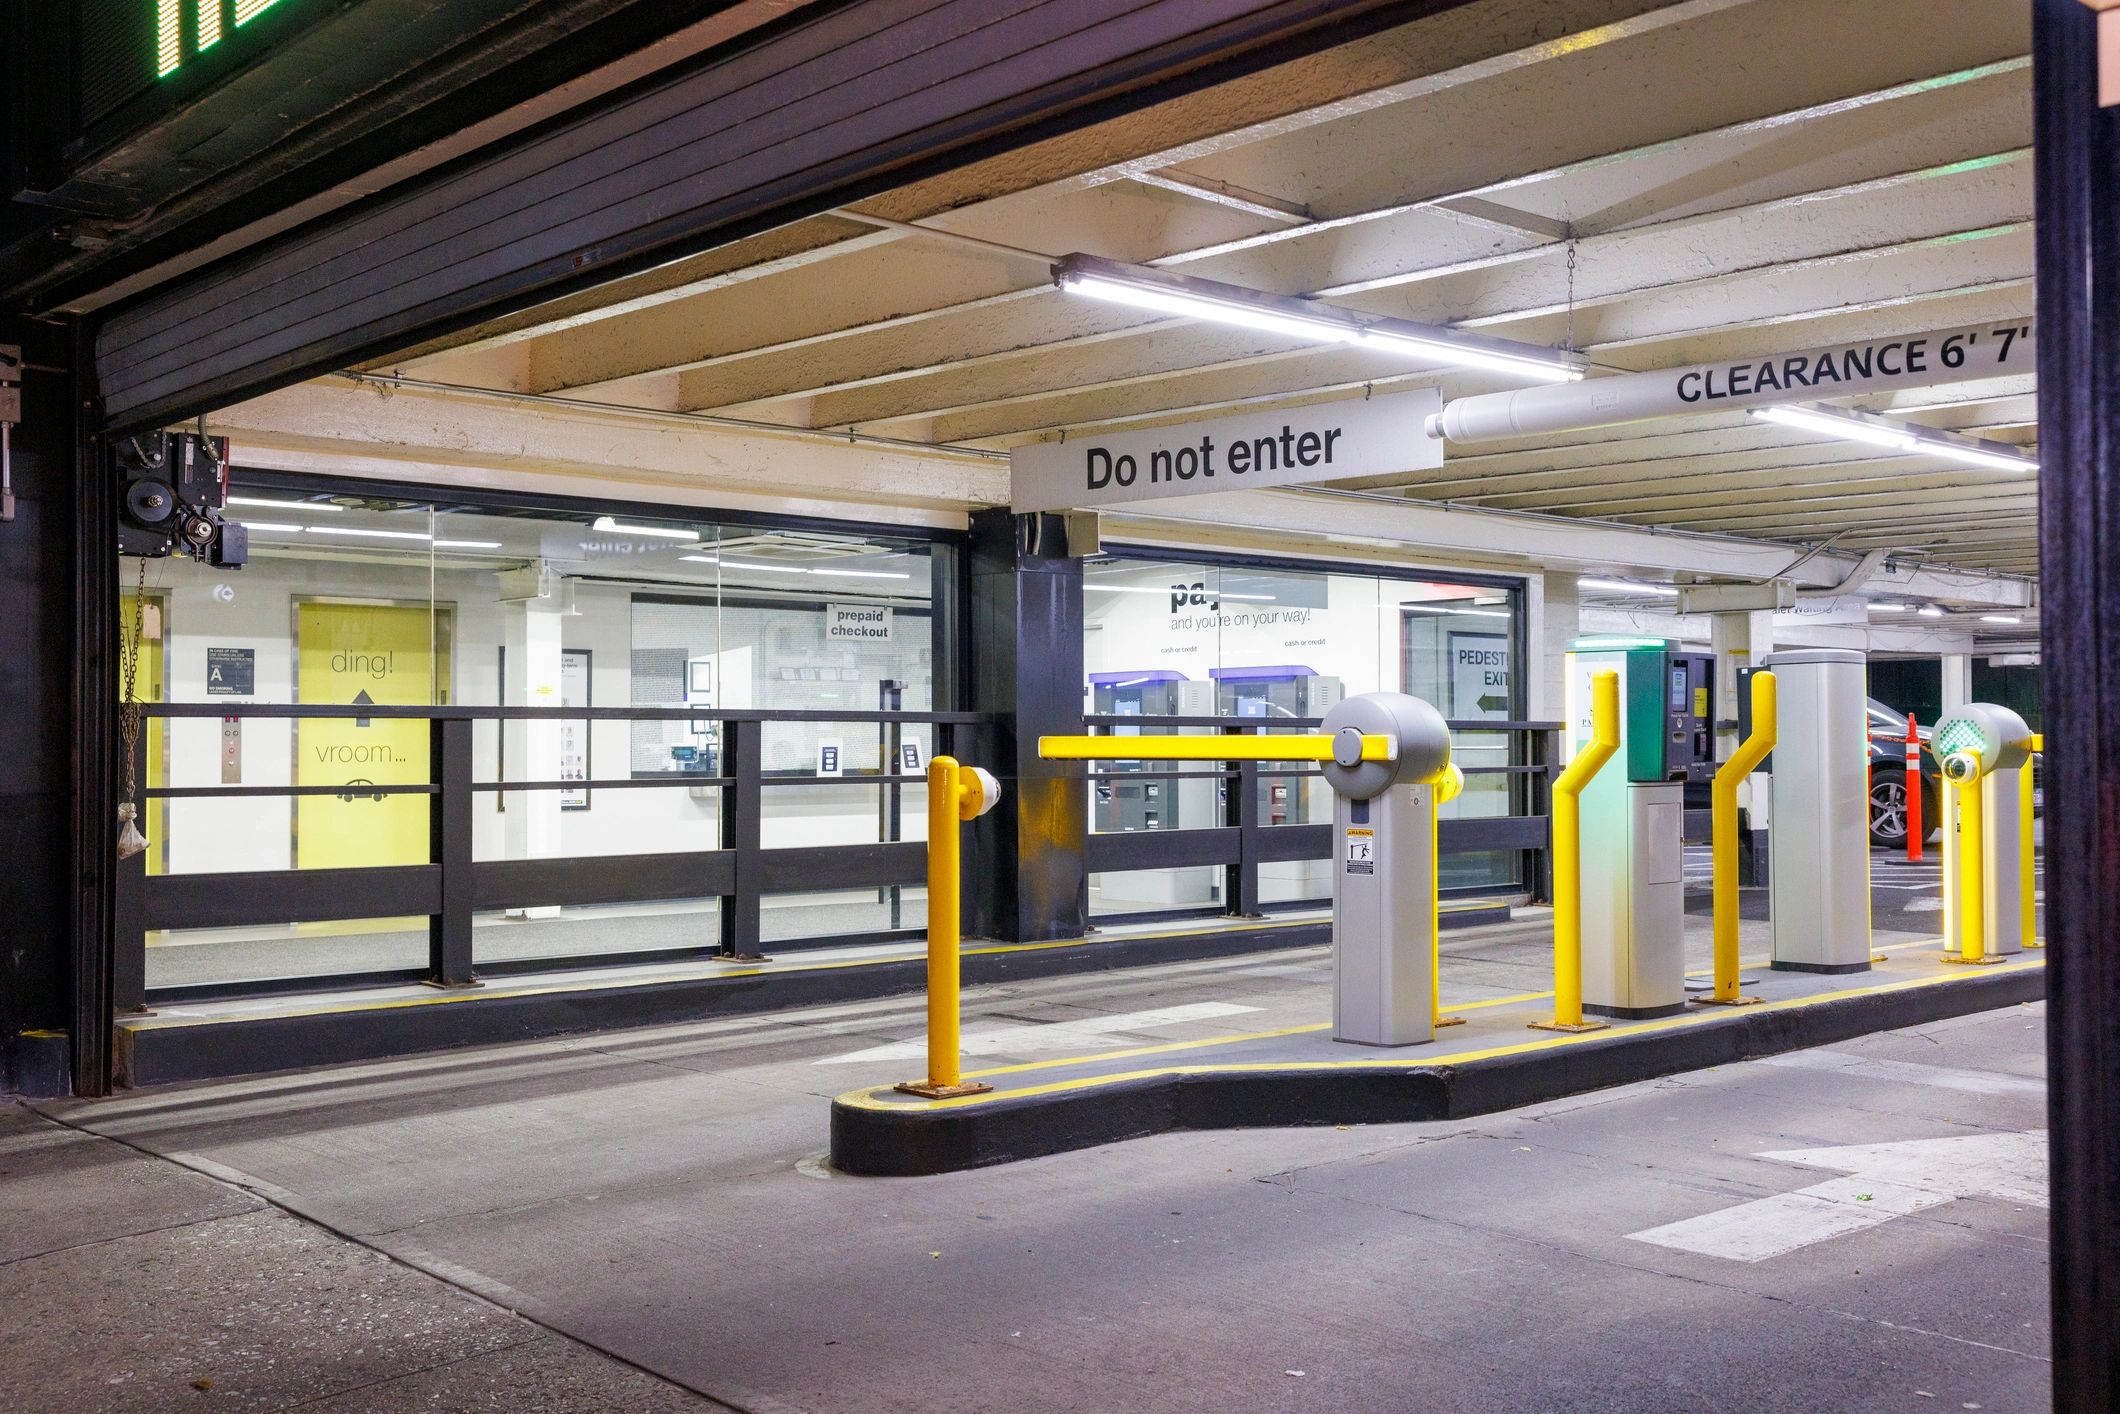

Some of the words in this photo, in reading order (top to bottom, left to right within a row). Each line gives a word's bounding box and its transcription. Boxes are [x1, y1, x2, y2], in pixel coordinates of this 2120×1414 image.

[1676, 339, 1928, 403] CLEARANCE
[1940, 333, 1976, 369] 6'
[1991, 325, 2030, 363] 7'
[1087, 447, 1137, 490] Do
[1151, 435, 1215, 483] not
[1227, 425, 1342, 475] enter
[837, 610, 884, 623] prepaid
[1171, 615, 1193, 630] and
[1196, 613, 1231, 632] you're
[1234, 614, 1249, 626] on
[1252, 612, 1279, 628] your
[1282, 607, 1311, 625] way!
[831, 624, 889, 638] checkout
[1160, 646, 1174, 654] cash
[1181, 645, 1198, 653] credit
[1284, 639, 1300, 648] cash
[1308, 638, 1326, 646] credit
[331, 649, 394, 680] ding!
[1459, 649, 1508, 666] PEDEST
[210, 667, 223, 681] A
[1484, 671, 1509, 686] EXIT
[315, 744, 406, 763] vroom...
